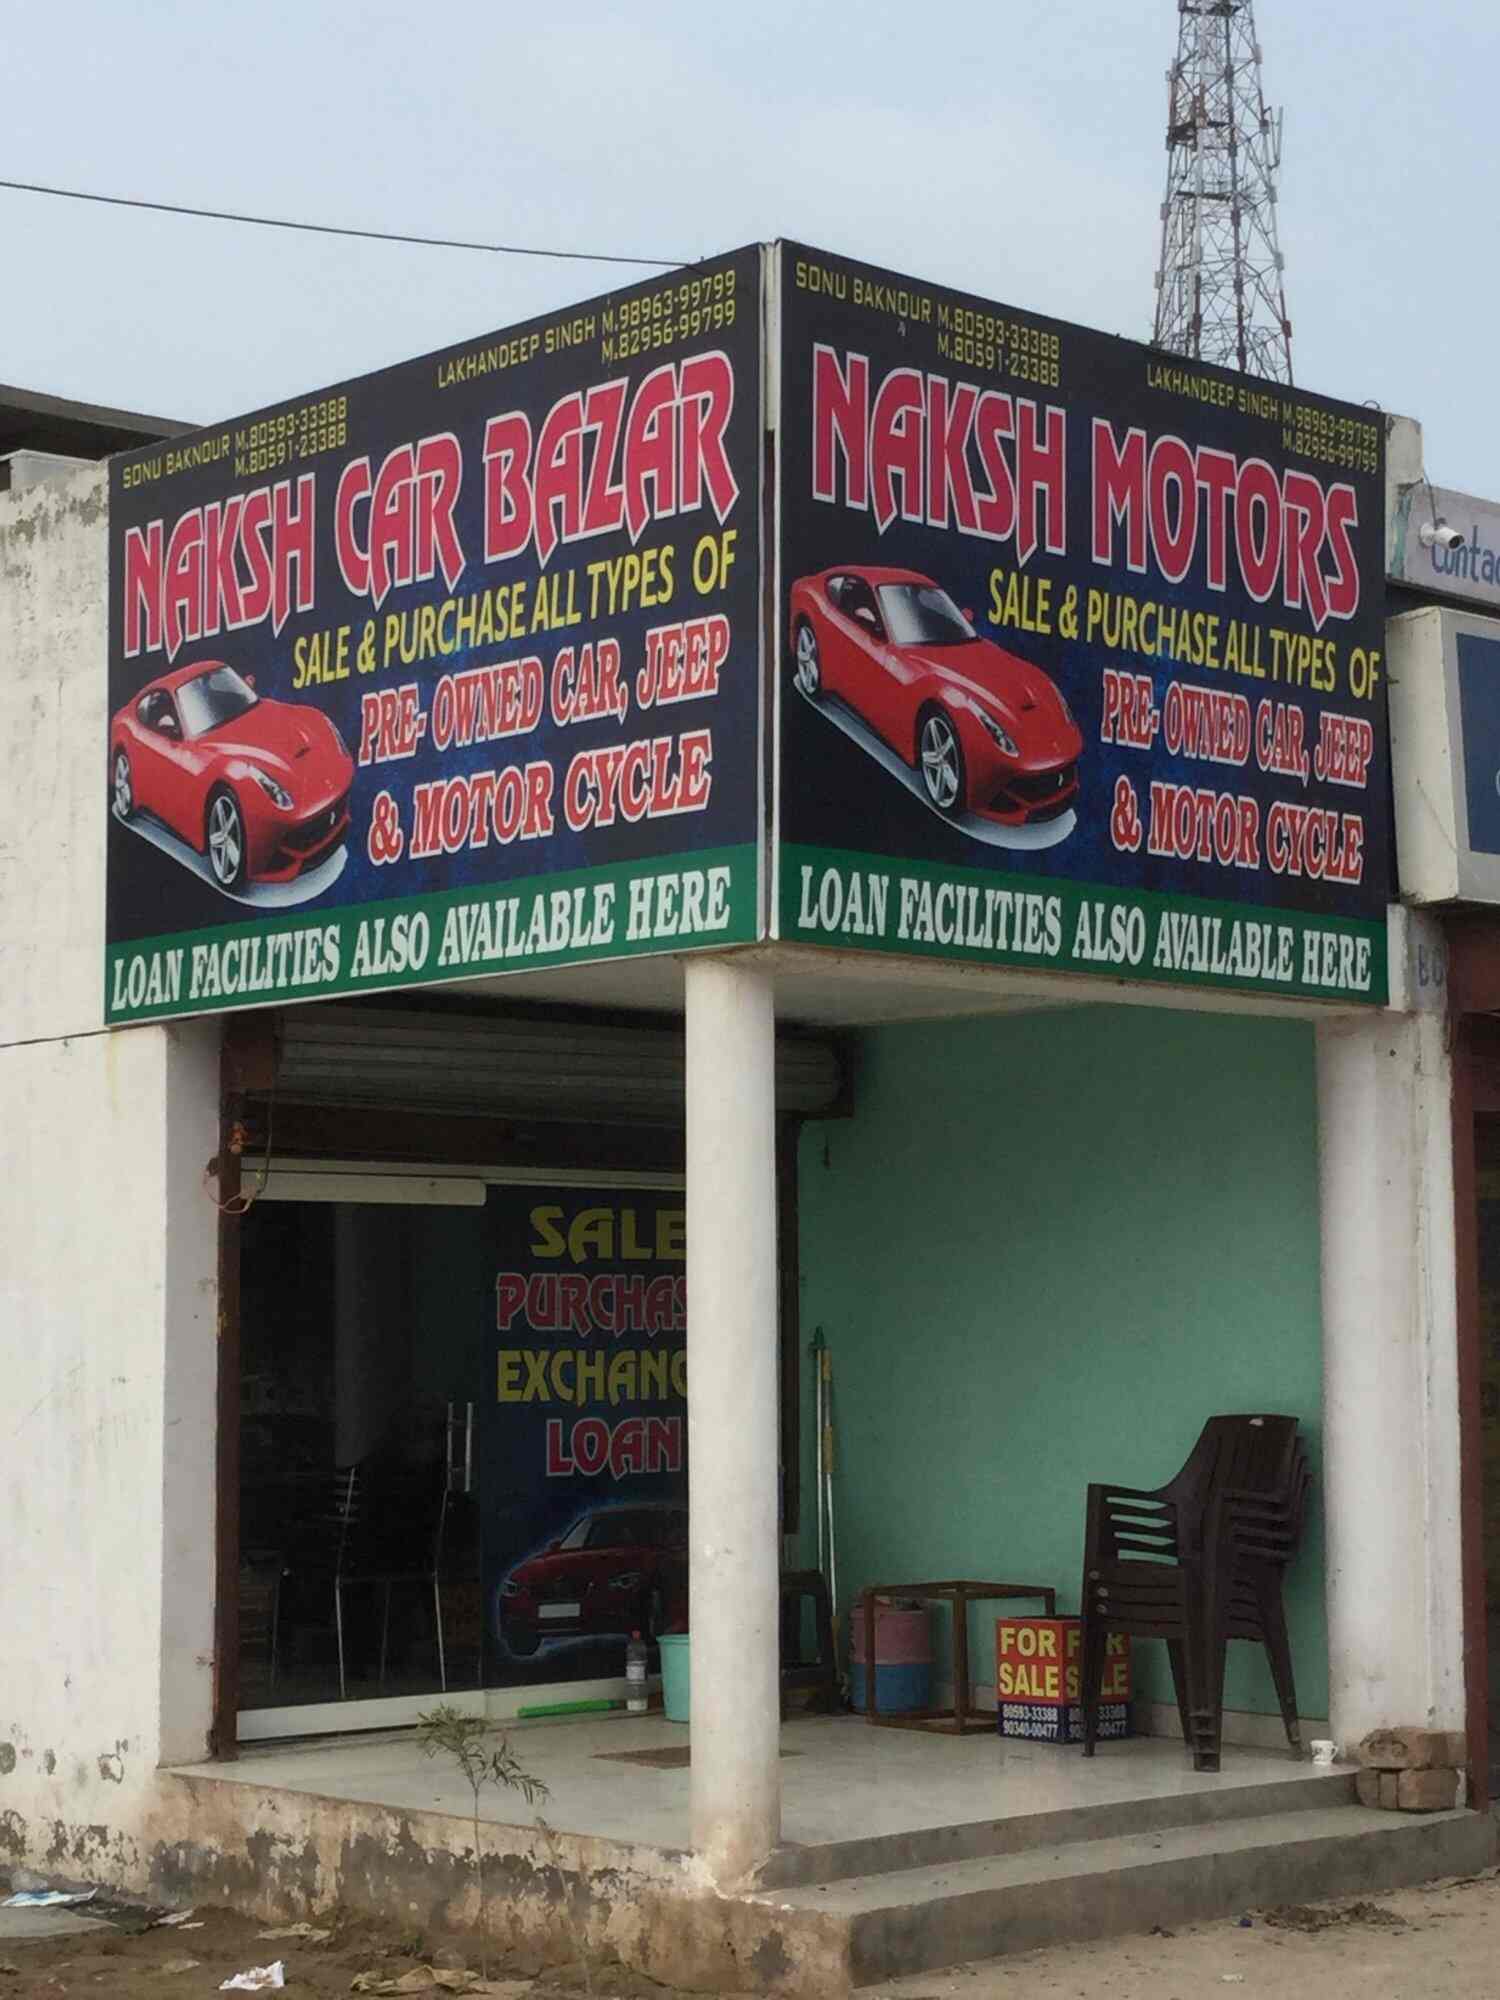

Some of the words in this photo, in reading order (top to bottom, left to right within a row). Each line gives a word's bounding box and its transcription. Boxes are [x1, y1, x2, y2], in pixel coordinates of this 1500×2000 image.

[795, 261, 847, 299] SONU
[853, 277, 931, 323] BAKNOUR
[437, 334, 540, 389] LAKHANDEEP
[545, 315, 596, 354] SINGH
[1147, 365, 1234, 408] LAKHANDEEP
[1238, 388, 1279, 420] SINGH
[122, 456, 162, 489] SONU
[166, 434, 230, 475] BAKNOUR
[124, 472, 315, 664] NAKSH
[335, 432, 467, 612] CAR
[482, 350, 740, 570] BAZAR
[812, 342, 1066, 568] NAKSH
[1091, 417, 1359, 632] MOTORS
[293, 626, 350, 688] SALE
[356, 620, 376, 673] &
[383, 582, 526, 668] PURCHASE
[530, 569, 582, 634] ALL
[587, 545, 674, 619] TYPES
[692, 529, 738, 594] OF
[987, 568, 1052, 635] SALE
[1058, 584, 1079, 640] &
[1087, 588, 1220, 669] PURCHASE
[1224, 619, 1266, 679] ALL
[1269, 628, 1336, 692] TYPES
[1349, 647, 1381, 700] OF
[358, 682, 427, 767] PRE-
[432, 655, 544, 752] OWNED
[550, 637, 629, 726] CAR,
[636, 613, 730, 710] JEEP
[1101, 668, 1160, 749] PRE-
[1164, 681, 1249, 766] OWNED
[1255, 698, 1309, 787] CAR,
[1314, 711, 1373, 788] JEEP
[367, 789, 403, 866] &
[409, 760, 553, 860] MOTOR
[563, 728, 713, 832] CYCLE
[1111, 774, 1142, 853] &
[1147, 780, 1260, 869] MOTOR
[1266, 801, 1364, 885] CYCLE
[111, 949, 184, 1011] LOAN
[189, 924, 341, 999] FACILITIES
[350, 911, 430, 978] ALSO
[437, 882, 615, 967] AVAILABLE
[625, 865, 731, 941] HERE
[798, 865, 889, 936] LOAN
[897, 877, 1062, 957] FACILITIES
[1071, 900, 1146, 965] ALSO
[1153, 911, 1294, 982] AVAILABLE
[1301, 929, 1372, 991] HERE
[529, 1206, 686, 1264] SALE
[496, 1272, 687, 1338] PURCHAS
[497, 1350, 687, 1407] EXCHAN
[546, 1417, 681, 1480] LOAN
[999, 1662, 1060, 1698] SALE
[1000, 1627, 1056, 1657] FOR
